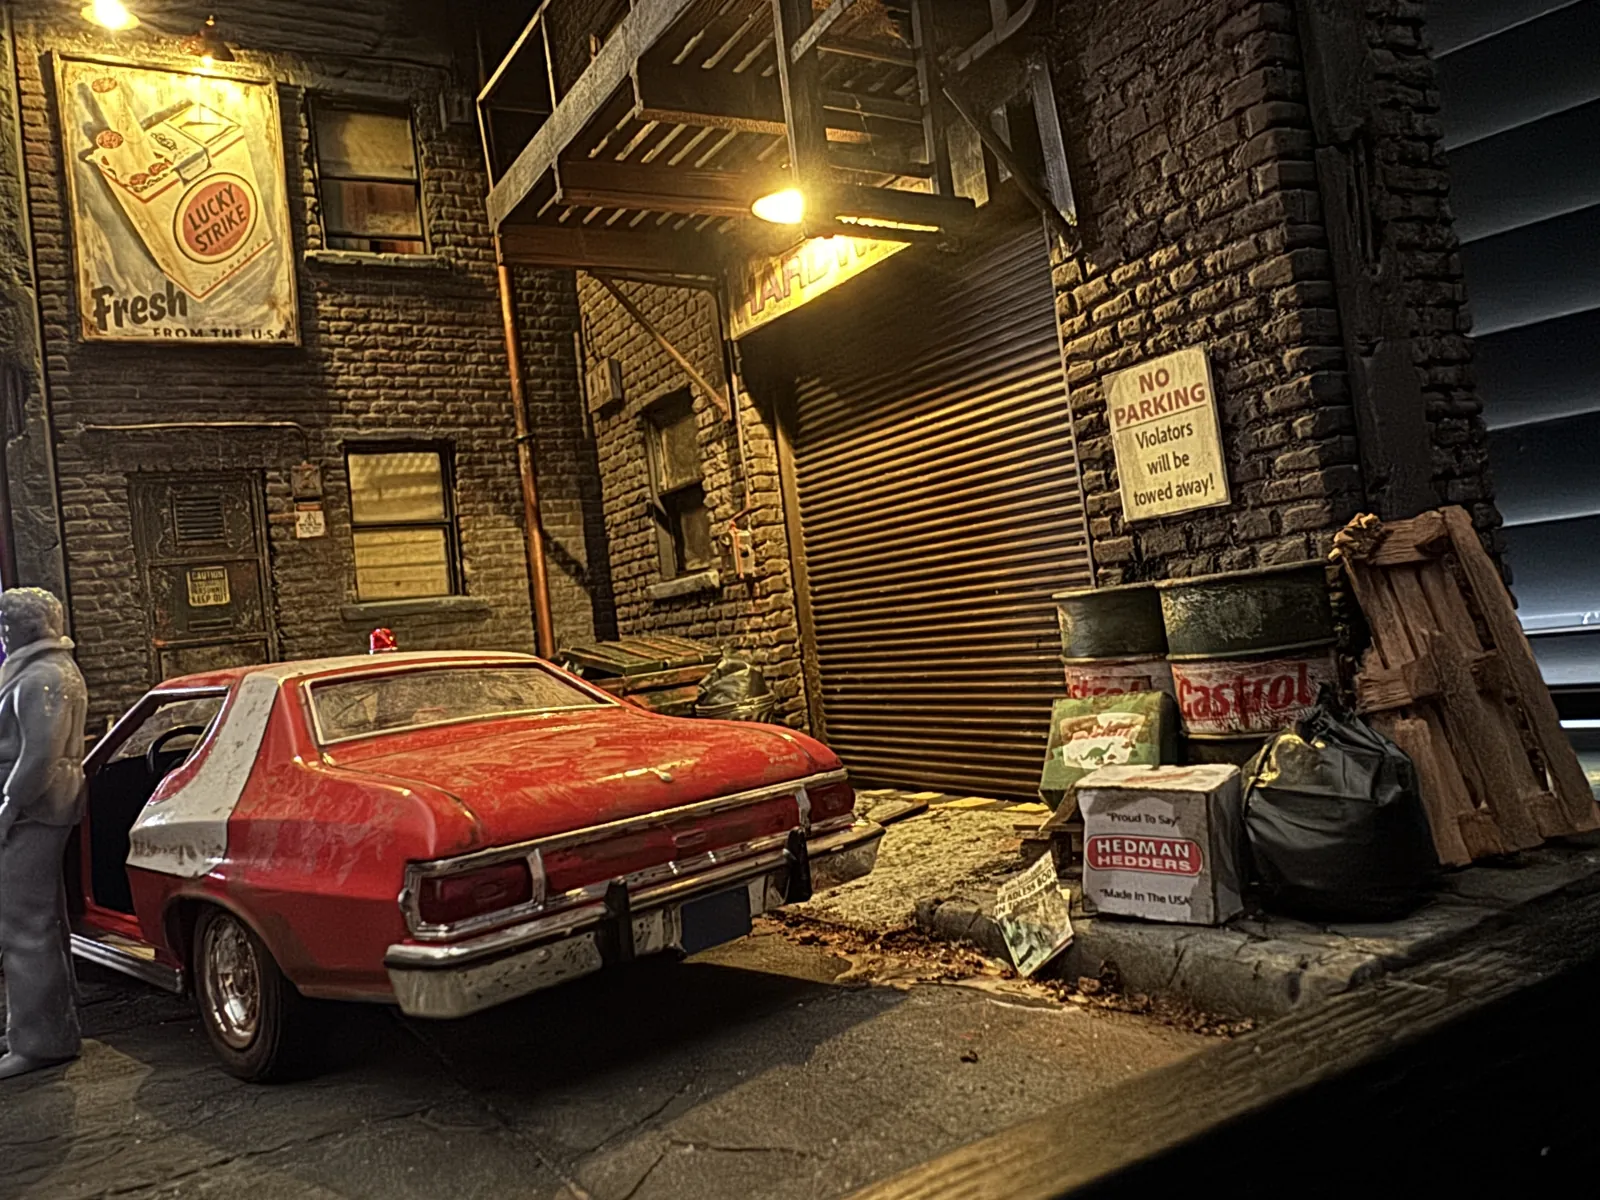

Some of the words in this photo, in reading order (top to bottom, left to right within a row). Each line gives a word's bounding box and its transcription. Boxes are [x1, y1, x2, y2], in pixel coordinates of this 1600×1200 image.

[188, 183, 235, 231] LUCKY
[195, 204, 247, 252] STRIKE
[91, 280, 188, 331] Fresh
[153, 327, 203, 338] FROM
[210, 328, 242, 338] THE
[1138, 368, 1170, 394] NO
[1114, 382, 1206, 427] PARKING
[1135, 422, 1194, 450] Violators
[1147, 452, 1171, 475] will
[1172, 451, 1190, 469] be
[1133, 481, 1173, 506] towed
[1175, 472, 1215, 497] away!
[1178, 662, 1313, 721] Castrol
[1144, 814, 1157, 825] To
[1097, 839, 1190, 858] HEDMAN
[1097, 855, 1192, 872] HEDDERS
[1134, 891, 1145, 901] In
[1147, 892, 1166, 904] The
